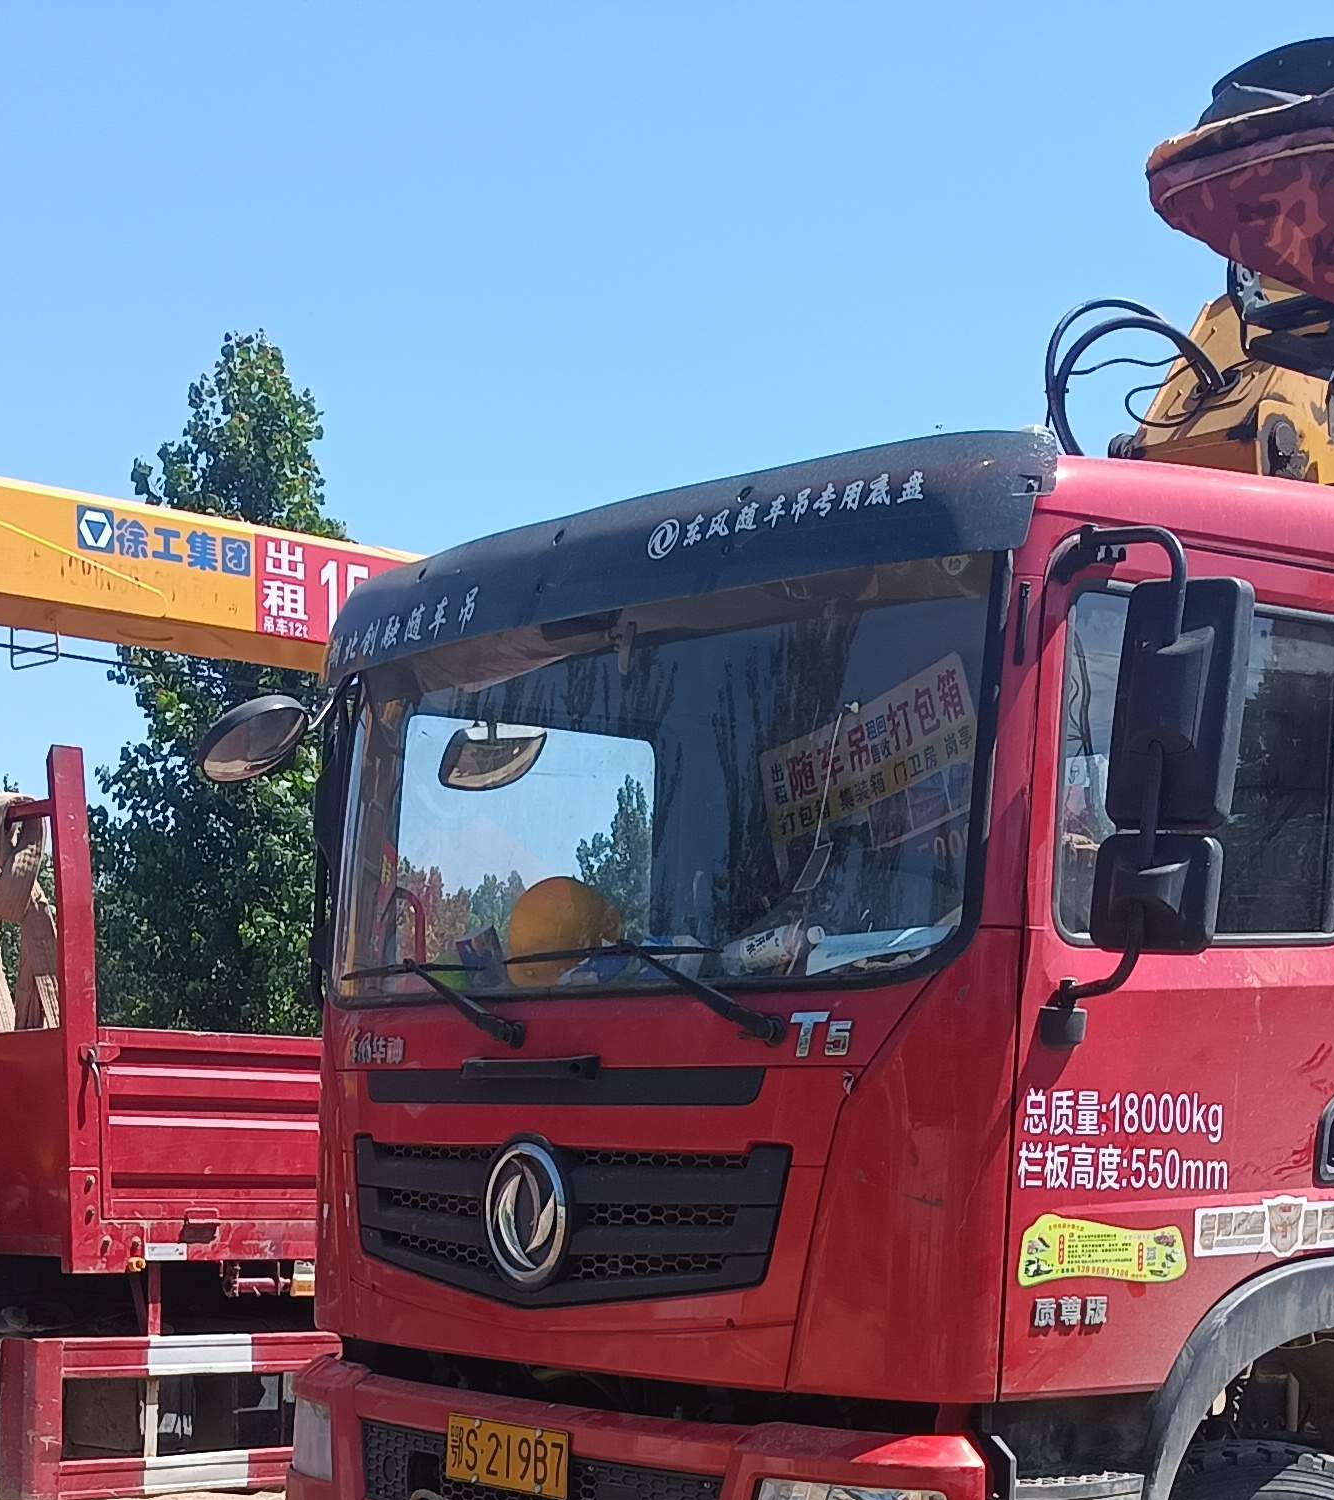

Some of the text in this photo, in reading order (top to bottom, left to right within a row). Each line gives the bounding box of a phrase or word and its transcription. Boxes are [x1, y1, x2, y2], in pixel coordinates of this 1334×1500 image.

[682, 471, 925, 547] 东风随车吊专用底盘
[114, 518, 251, 576] 徐工集团
[262, 539, 309, 621] 出租
[263, 615, 309, 639] 吊车12t
[886, 668, 966, 751] 打包箱
[786, 724, 872, 801] 随车吊
[789, 1011, 855, 1058] T5
[1023, 1087, 1223, 1143] 总质量:18000kg
[1018, 1141, 1228, 1190] 栏板高度:550mm
[1033, 1296, 1108, 1328] 质尊版
